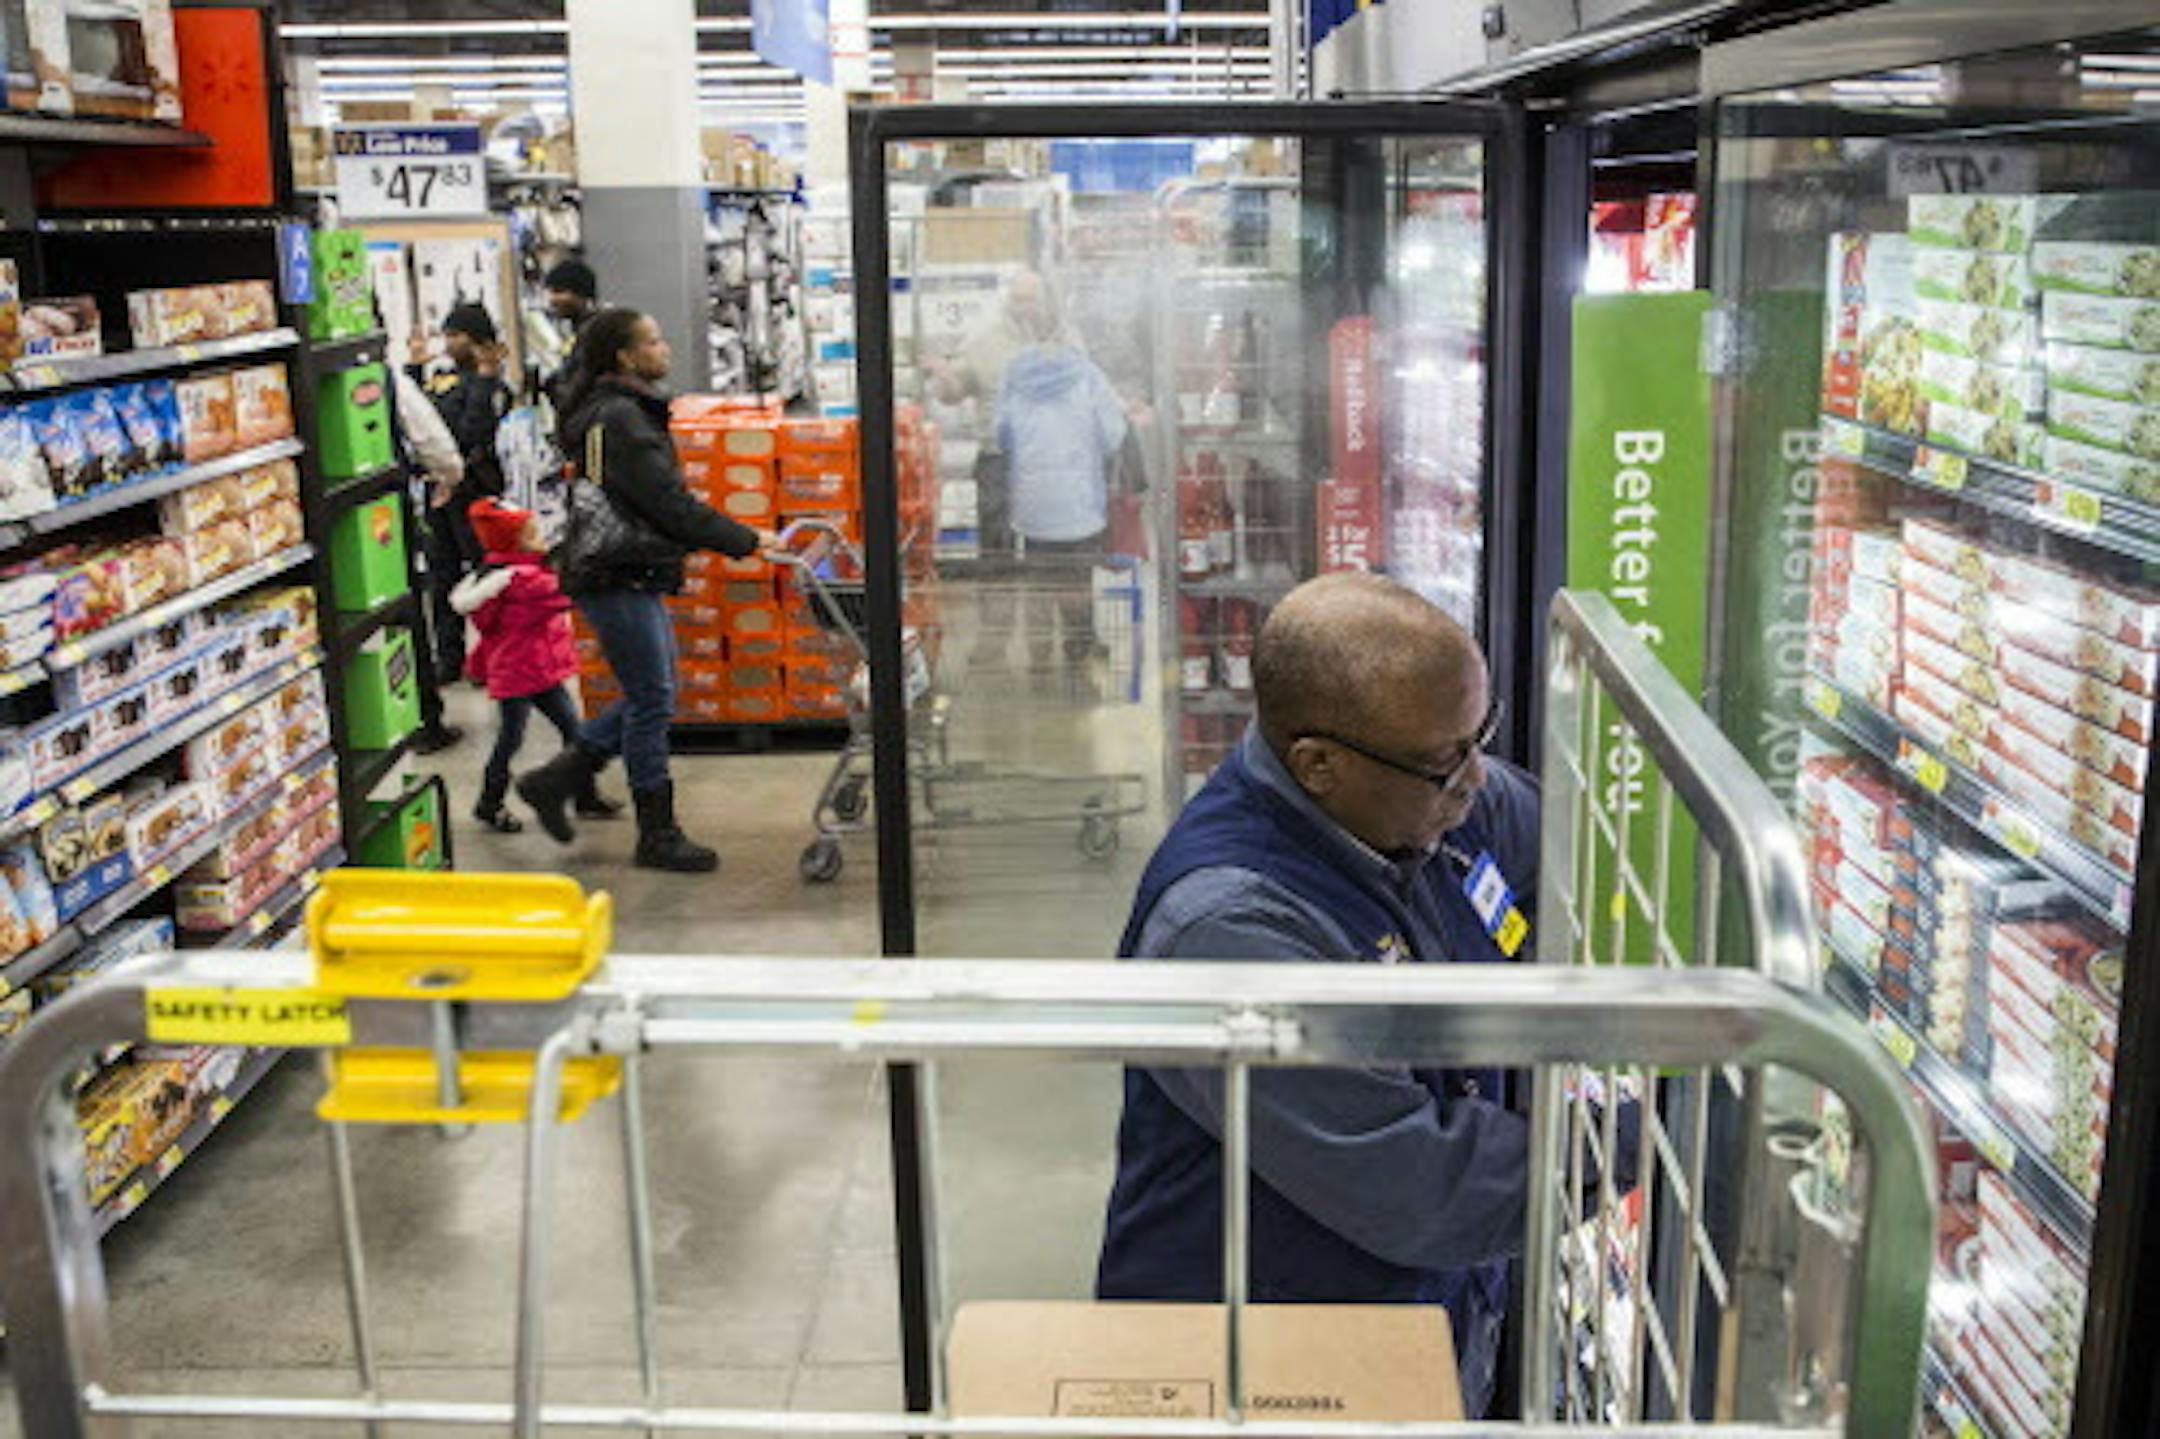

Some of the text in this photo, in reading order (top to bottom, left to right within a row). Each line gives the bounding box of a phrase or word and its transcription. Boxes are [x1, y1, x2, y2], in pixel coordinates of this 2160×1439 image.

[1611, 430, 1664, 607] Better
[153, 1002, 346, 1023] SAFETY LATCH
